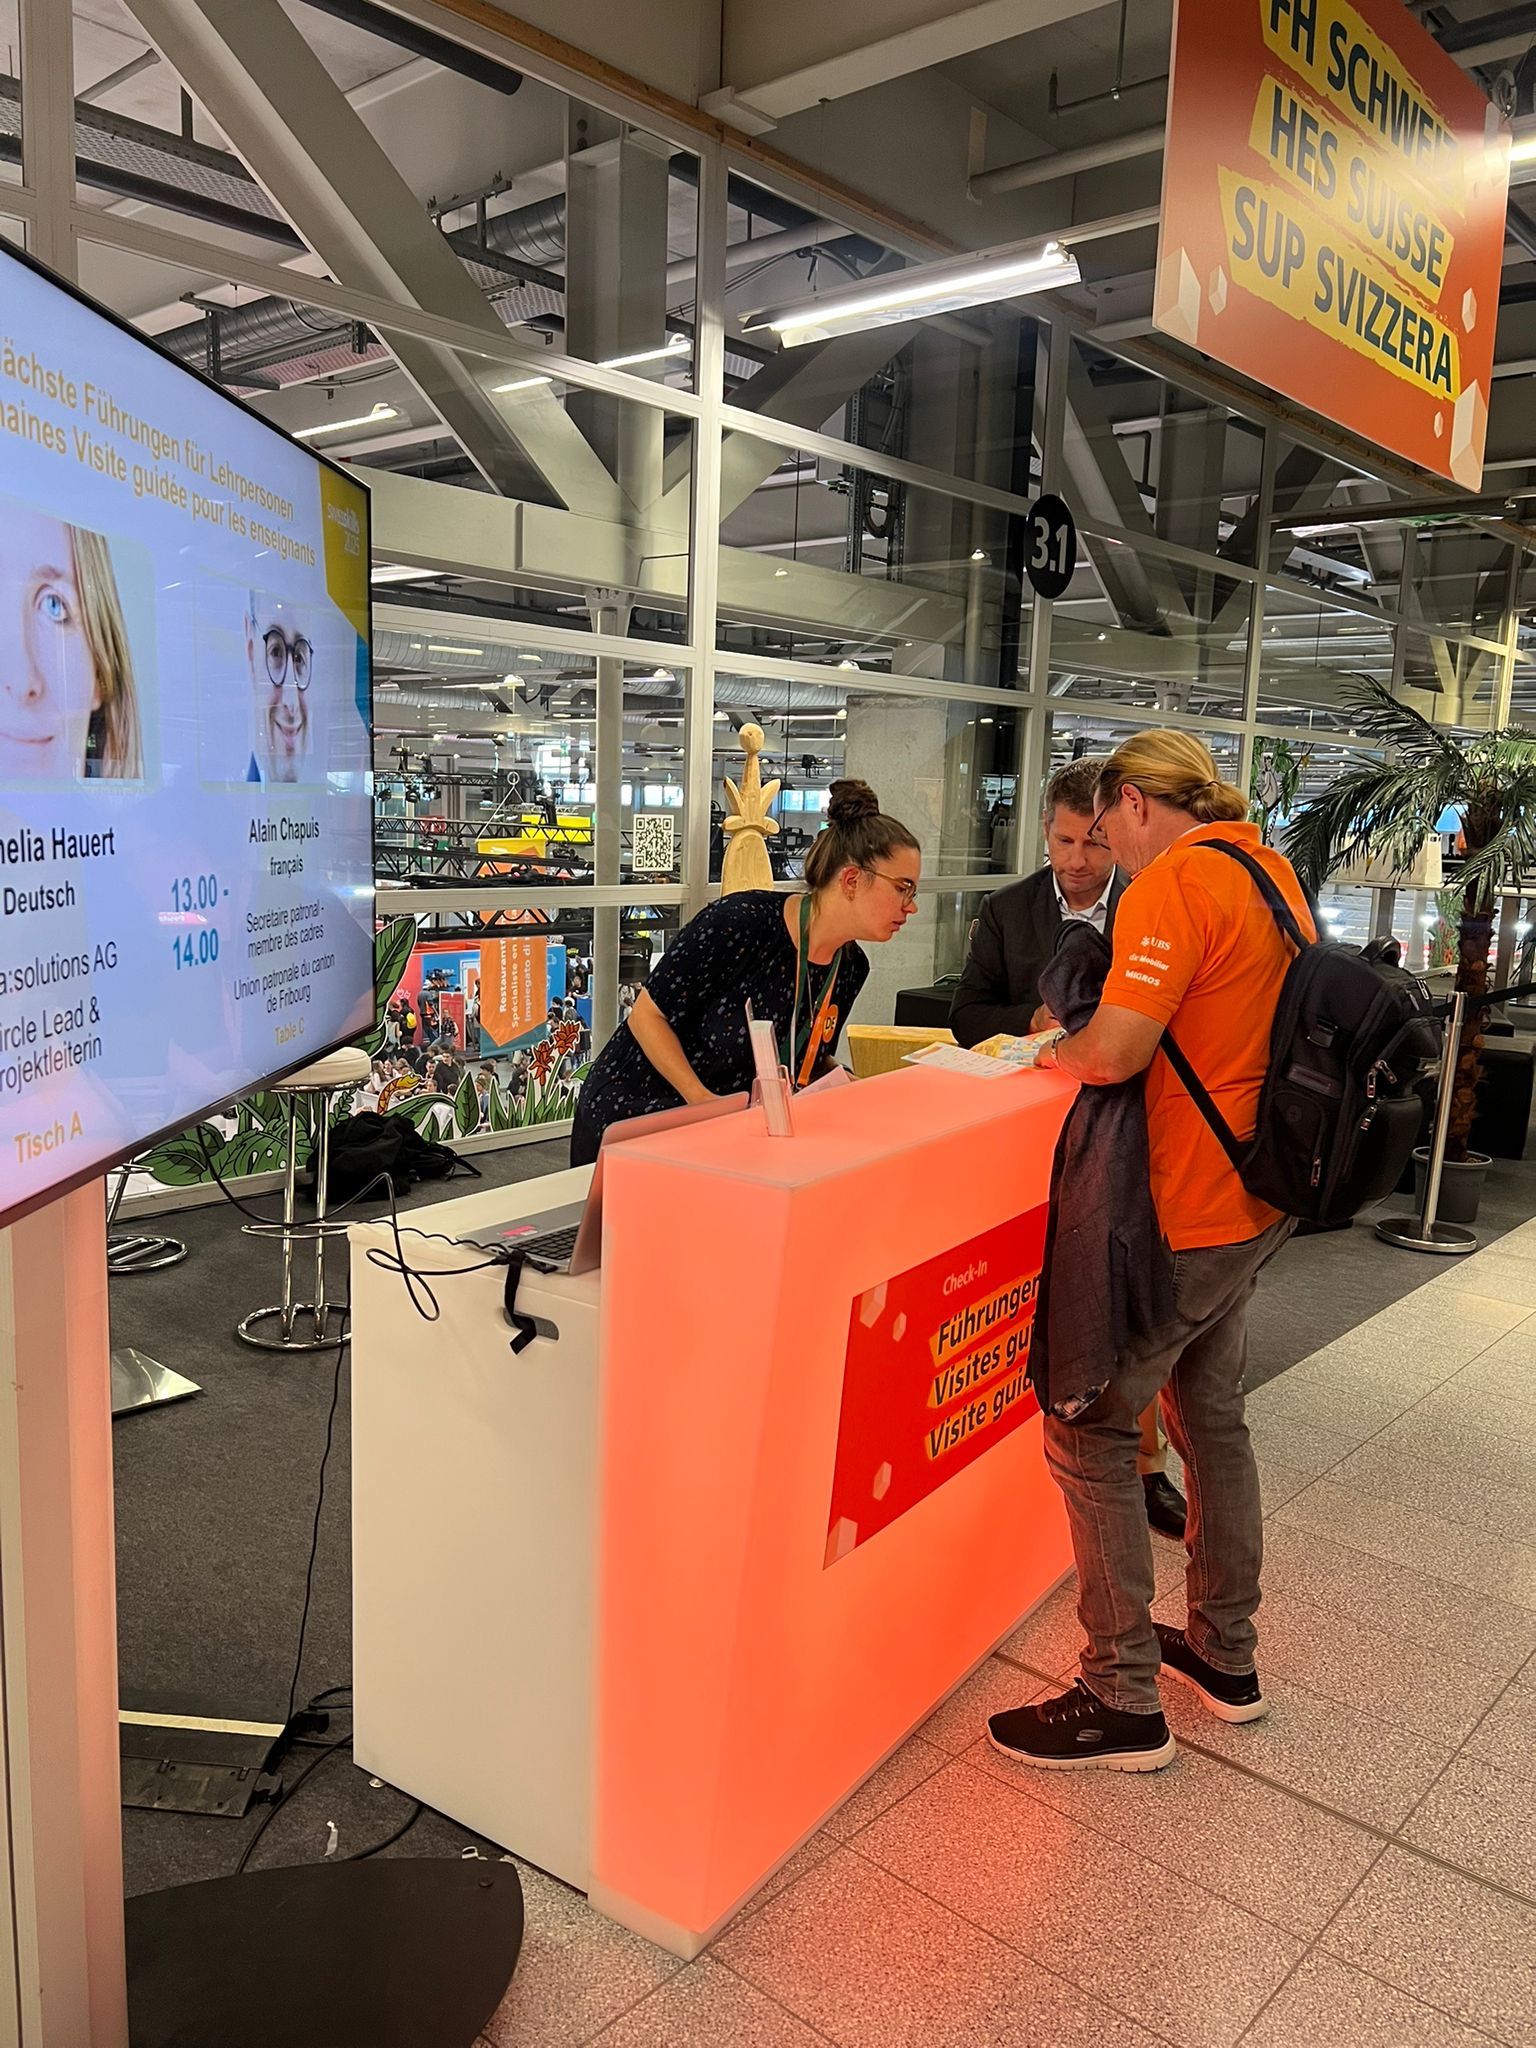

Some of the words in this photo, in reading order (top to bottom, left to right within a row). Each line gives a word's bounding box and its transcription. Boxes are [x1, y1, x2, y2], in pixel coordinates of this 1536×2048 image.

[1270, 84, 1338, 199] HES
[1347, 156, 1445, 288] SUISSE
[1231, 185, 1305, 289] SUP
[1313, 245, 1452, 394] SVIZZERA
[0, 336, 77, 409] ächste
[83, 382, 180, 462] Führungen
[184, 439, 205, 474] für
[209, 452, 294, 521] Lehrpersonen
[72, 424, 127, 481] Visite
[132, 463, 187, 508] guidée
[192, 490, 224, 525] pour
[228, 502, 247, 536] les
[250, 519, 316, 568] enseignants
[1031, 516, 1068, 574] 3.1
[52, 826, 115, 860] Hauert
[249, 818, 277, 843] Alain
[280, 816, 320, 845] Chapuis
[270, 854, 303, 878] français
[3, 880, 75, 915] Deutsch
[171, 874, 217, 912] 13.00
[246, 906, 288, 933] Secrétaire
[290, 899, 320, 927] patronal
[93, 941, 118, 972] AG
[173, 928, 219, 970] 14.00
[248, 934, 283, 958] membre
[284, 929, 299, 948] des
[300, 923, 325, 943] cadres
[1150, 937, 1171, 951] UBS
[233, 977, 260, 1000] Union
[262, 962, 300, 995] patronale
[301, 959, 311, 978] du
[311, 953, 336, 974] canton
[1125, 969, 1161, 987] MIGROS
[1139, 955, 1170, 971] Mobiliar
[266, 993, 278, 1014] de
[279, 984, 311, 1009] Fribourg
[511, 962, 520, 1028] Spécialiste
[524, 959, 532, 1022] Impiegato
[43, 999, 83, 1038] Lead
[89, 996, 100, 1024] &
[275, 1022, 297, 1045] Table
[299, 1016, 305, 1034] C
[14, 1120, 65, 1164] Tisch
[70, 1111, 83, 1140] A
[943, 1259, 988, 1296] Check-In
[934, 1344, 1000, 1406] Visites
[930, 1400, 987, 1458] Visite
